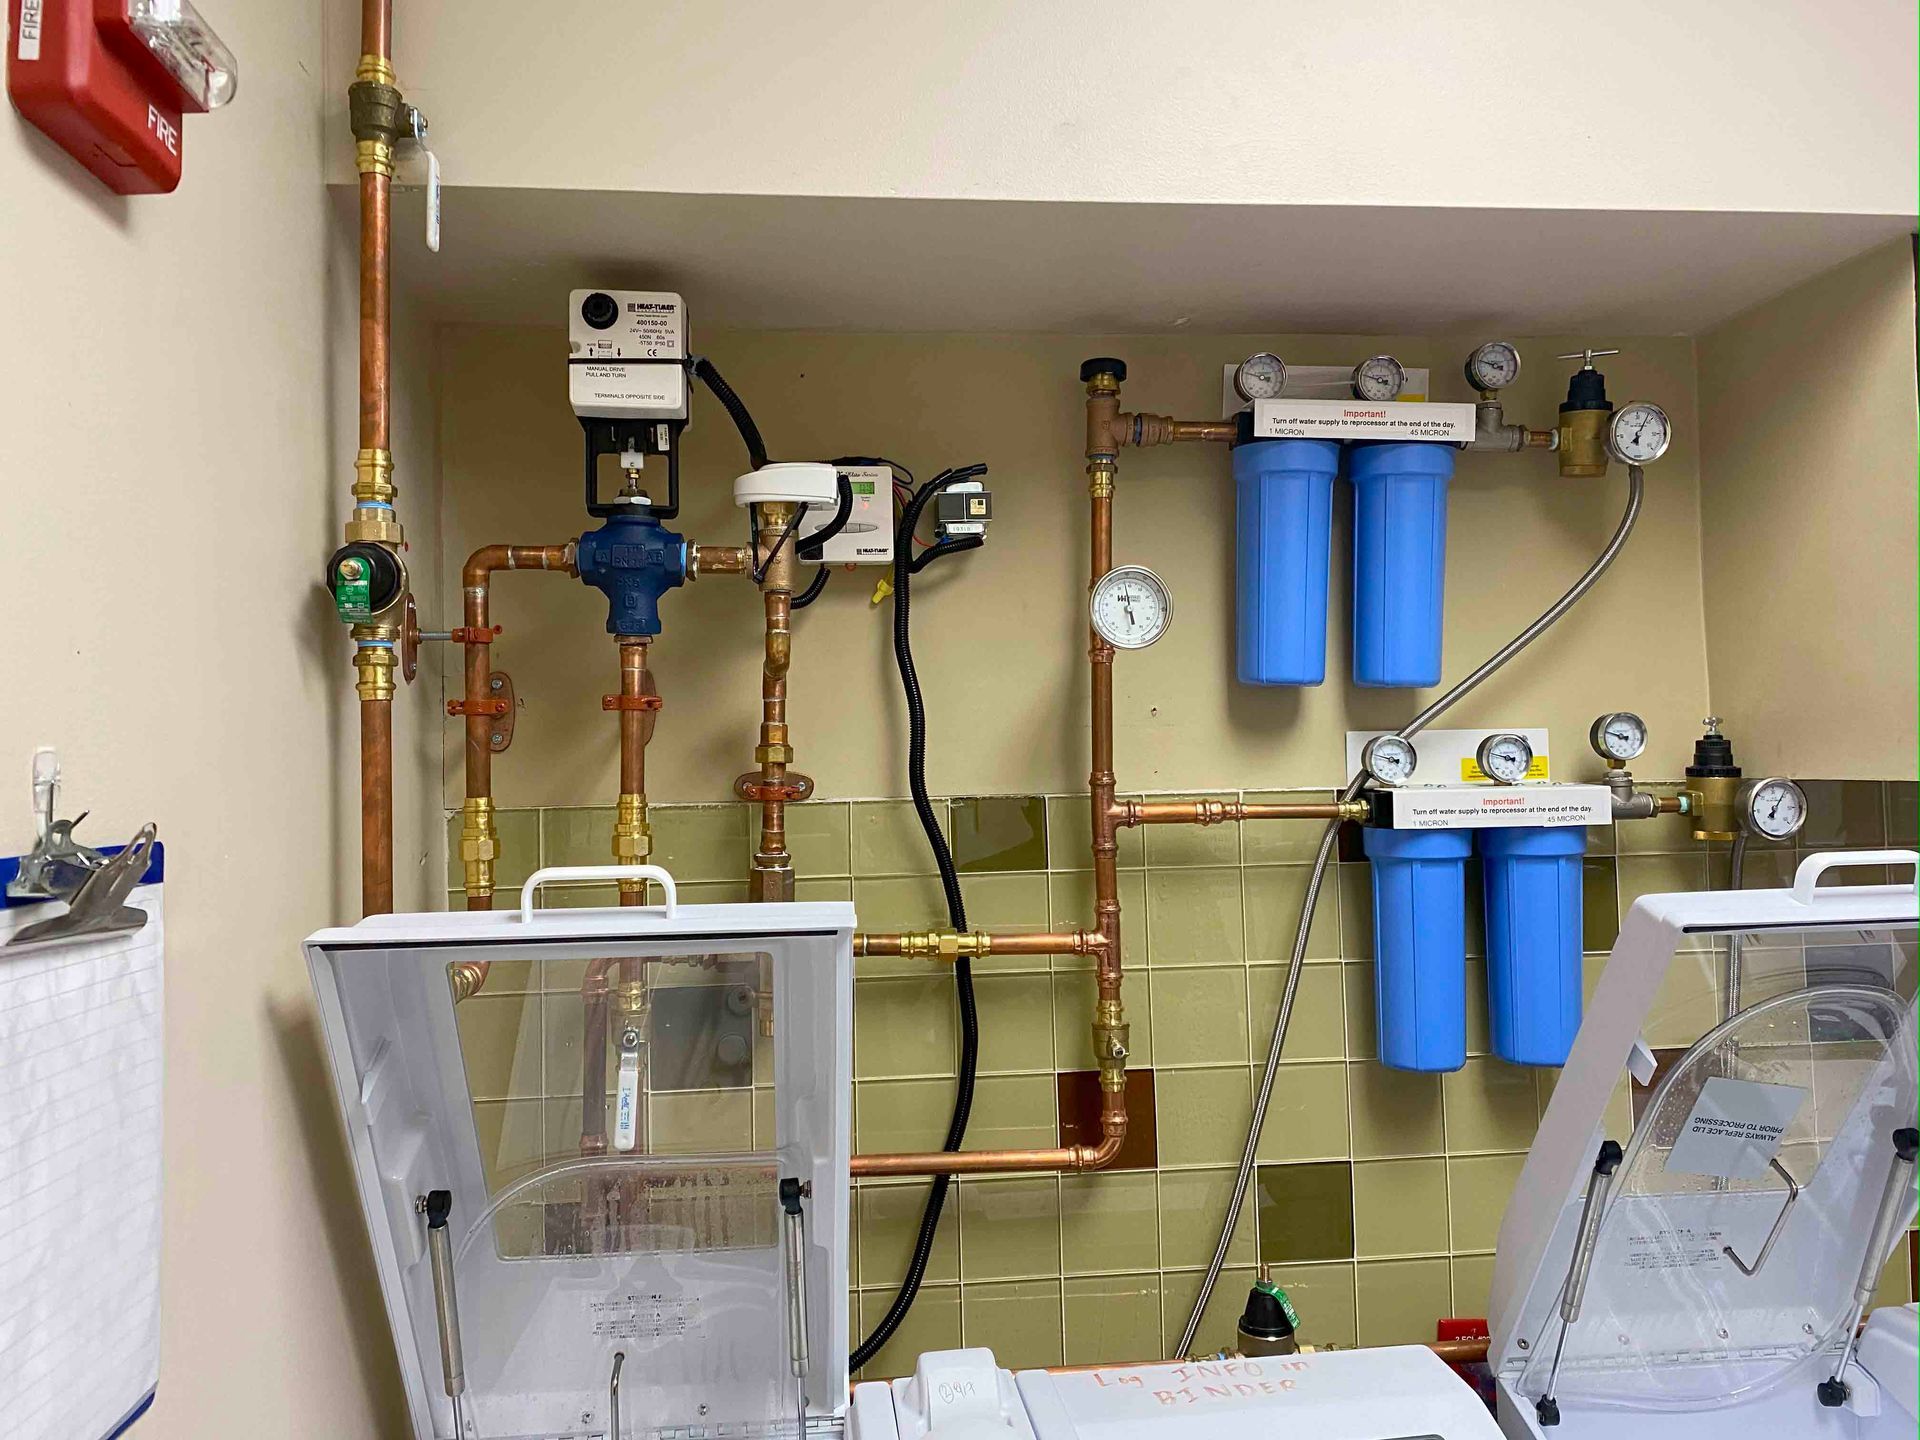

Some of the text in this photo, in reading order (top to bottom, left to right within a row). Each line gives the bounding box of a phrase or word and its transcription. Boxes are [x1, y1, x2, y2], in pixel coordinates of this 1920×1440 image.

[22, 0, 40, 39] FIRE
[148, 103, 177, 157] FIRE
[1343, 409, 1386, 418] Important!
[1349, 420, 1388, 428] reprocessor
[1442, 421, 1456, 429] day.
[1275, 428, 1305, 436] MICRON
[1483, 798, 1525, 806] Important!
[1556, 814, 1586, 822] MICRON
[1418, 819, 1449, 827] MICRON
[1694, 1116, 1784, 1134] PRIOR TO PROCESSING
[1706, 1127, 1744, 1138] REPLACE
[1745, 1132, 1777, 1141] ALWAYS
[1093, 1373, 1144, 1389] Log
[1171, 1361, 1264, 1383] INFO
[1153, 1379, 1303, 1405] BINDER
